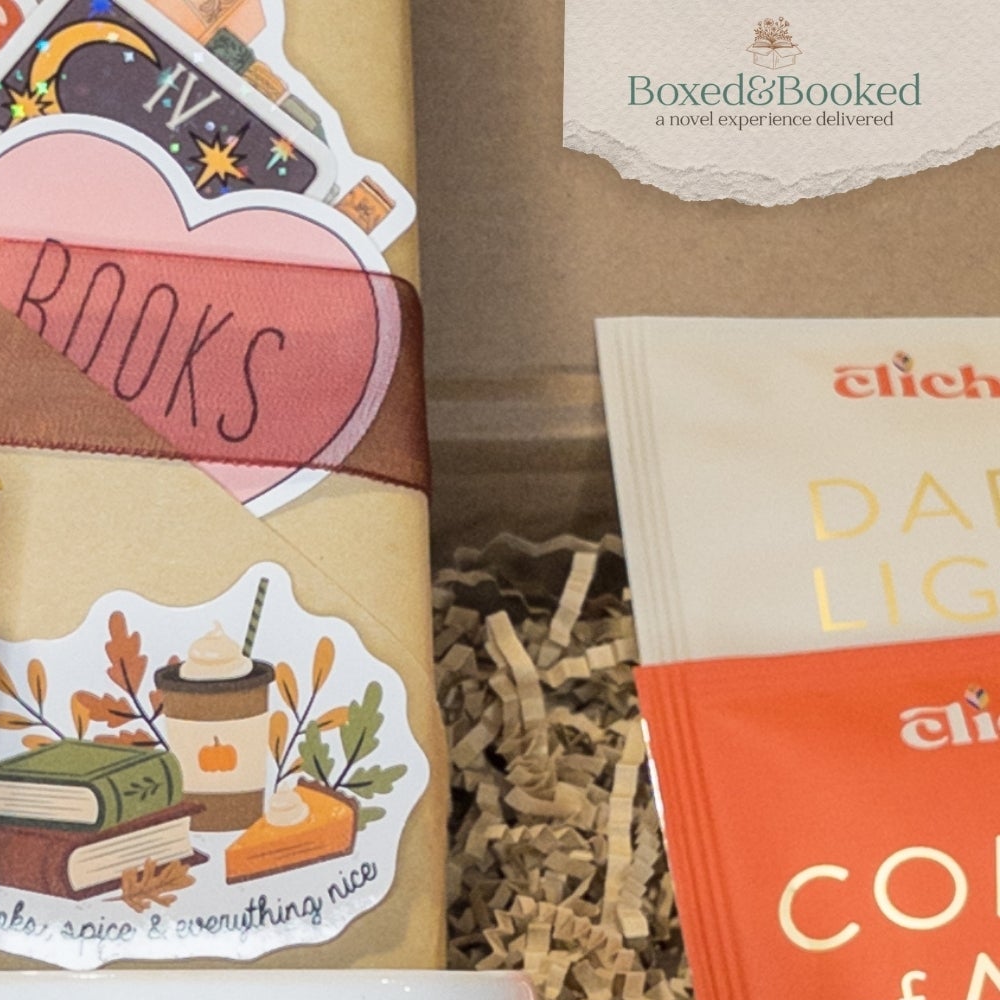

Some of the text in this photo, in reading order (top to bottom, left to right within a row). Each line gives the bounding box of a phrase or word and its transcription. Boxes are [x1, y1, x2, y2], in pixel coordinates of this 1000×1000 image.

[142, 62, 222, 131] IV
[17, 237, 286, 443] BOOKS
[808, 469, 1000, 541] DA
[900, 684, 1000, 750] cli
[60, 916, 136, 956] spice
[147, 913, 167, 940] &
[176, 894, 322, 942] everything
[327, 861, 378, 904] nice
[779, 835, 1000, 951] CO
